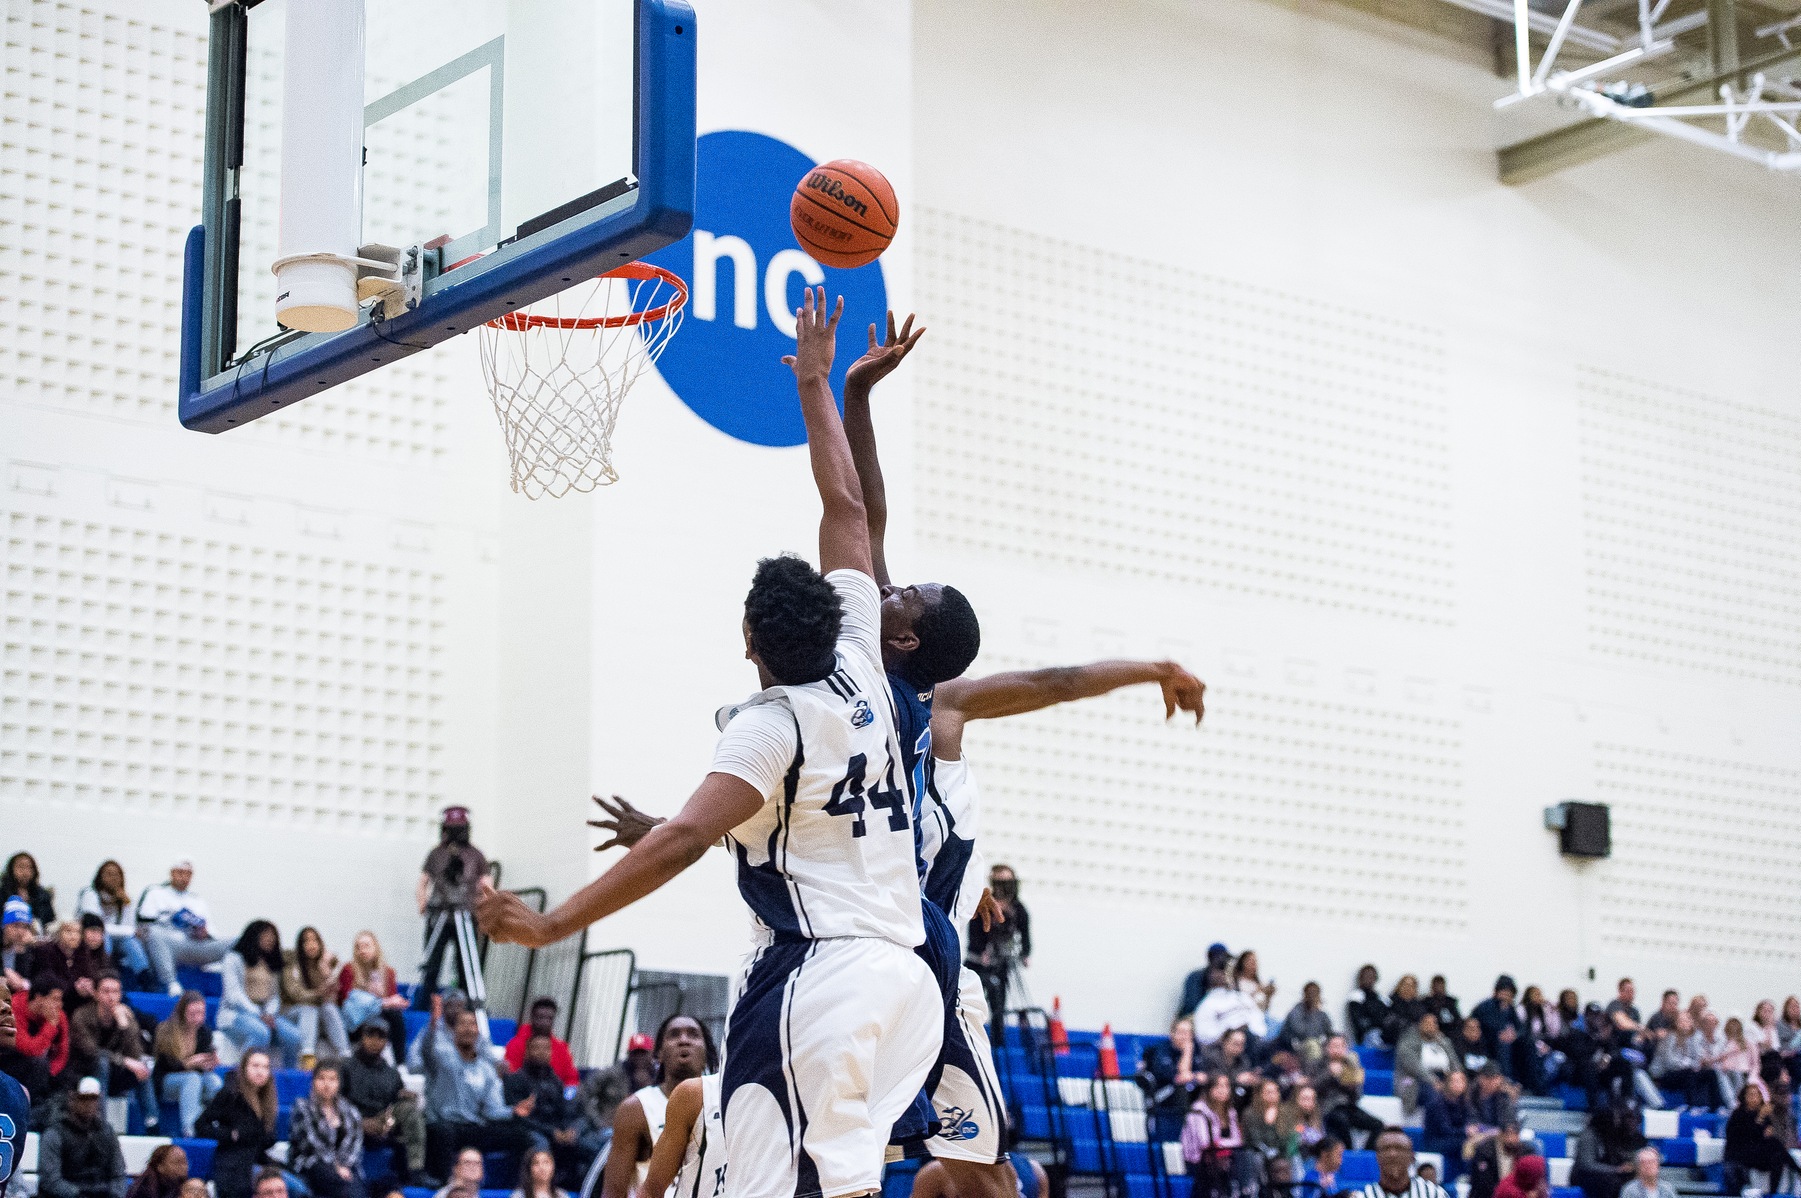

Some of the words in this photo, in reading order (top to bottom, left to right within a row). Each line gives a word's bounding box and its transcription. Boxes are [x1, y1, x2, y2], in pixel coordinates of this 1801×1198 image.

[807, 172, 868, 218] Wilson
[693, 228, 825, 340] nc
[821, 752, 909, 837] 44
